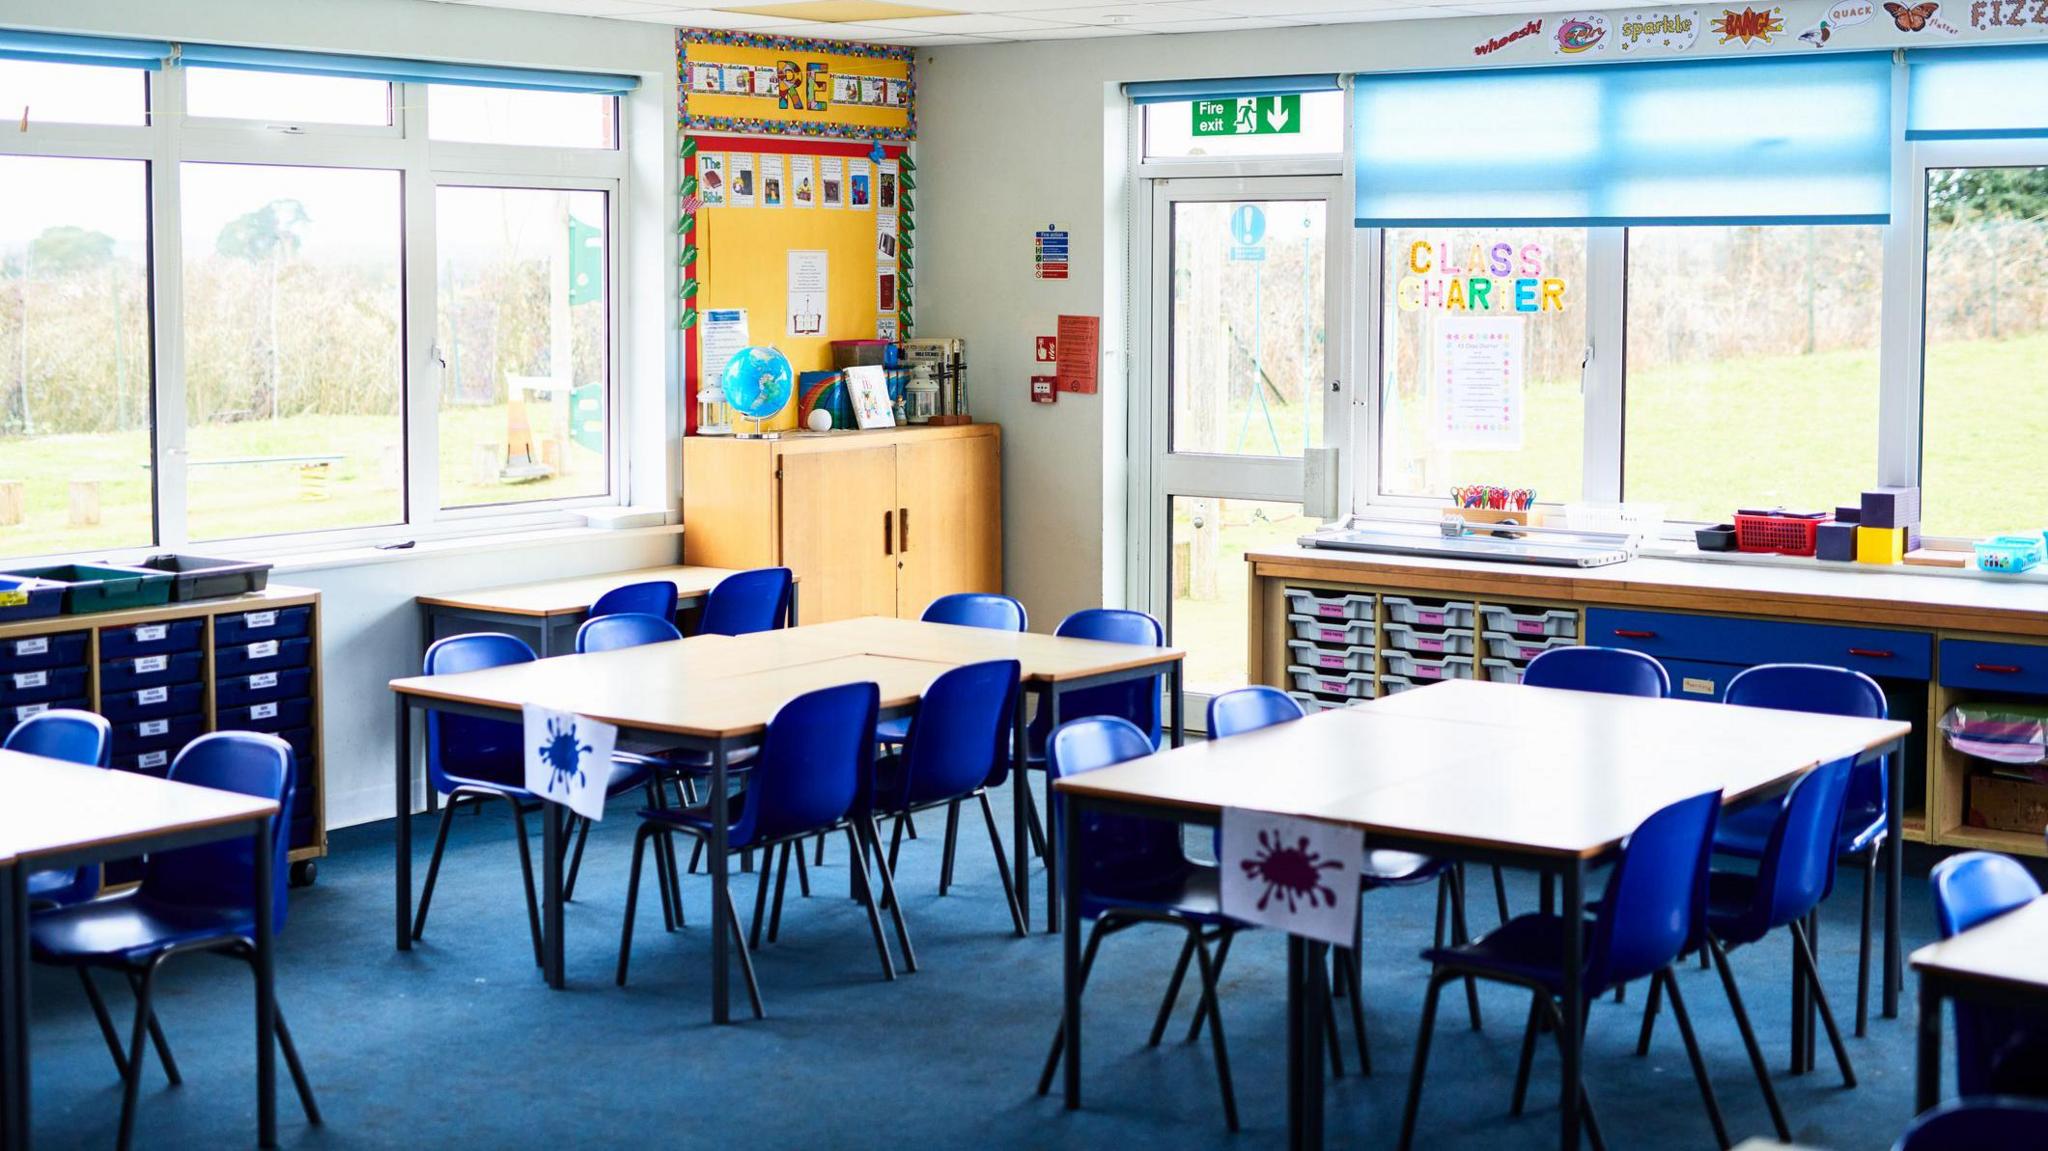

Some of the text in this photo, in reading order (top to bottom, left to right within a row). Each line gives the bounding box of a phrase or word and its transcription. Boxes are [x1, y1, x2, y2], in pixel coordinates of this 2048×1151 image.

[1833, 6, 1872, 19] QUACK
[1622, 14, 1693, 43] sparkle
[1726, 11, 1770, 36] BANG!
[1928, 18, 1959, 36] flutter
[1473, 19, 1543, 56] whoosh!
[777, 60, 829, 111] RE
[1199, 101, 1224, 116] Fire
[1199, 118, 1224, 132] exit
[701, 156, 721, 169] The
[703, 190, 723, 203] Bible
[1409, 240, 1542, 278] CLASS
[1397, 276, 1566, 312] CHARTER
